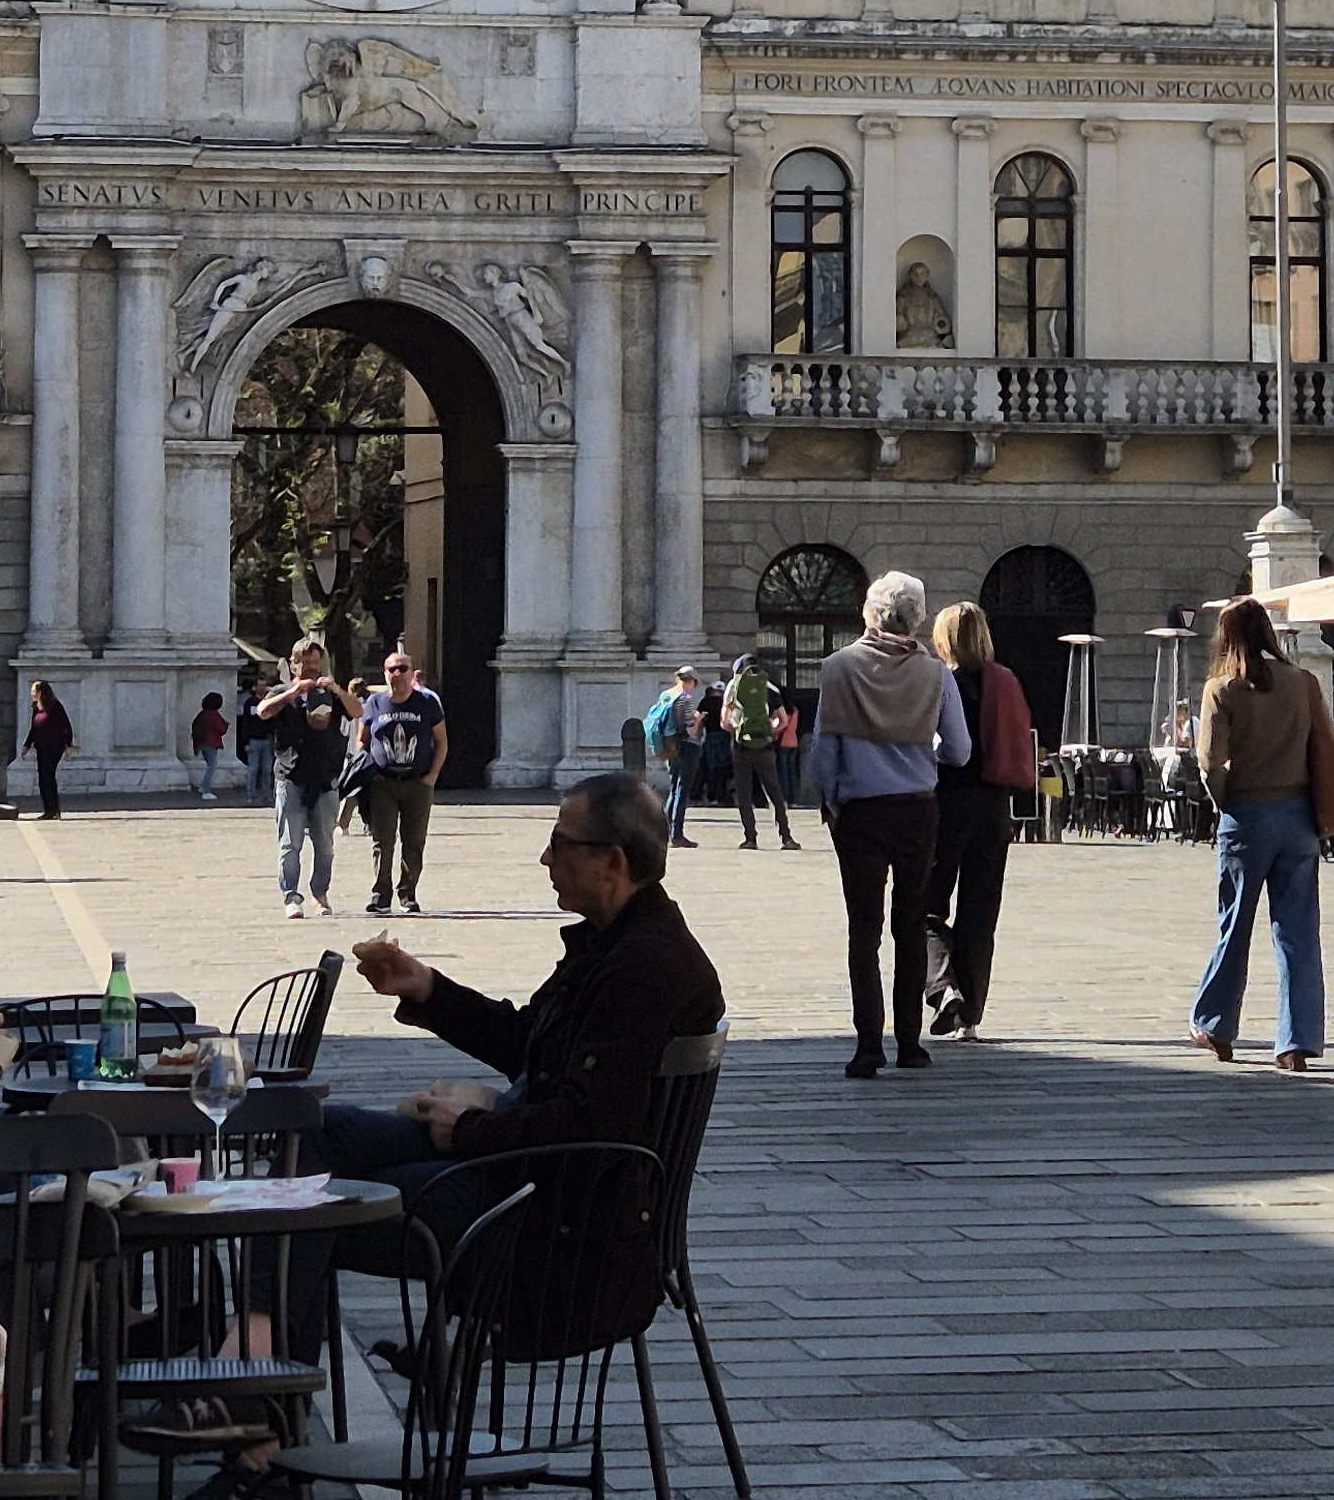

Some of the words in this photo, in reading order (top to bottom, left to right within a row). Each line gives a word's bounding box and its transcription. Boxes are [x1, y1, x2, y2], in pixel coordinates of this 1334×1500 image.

[754, 73, 801, 92] FORI
[814, 75, 914, 93] FRONTEM
[1027, 79, 1144, 97] HABITATIONI
[1155, 81, 1274, 99] SPECTACVLO
[43, 184, 162, 204] SENATVS
[198, 189, 314, 209] VENETVS
[335, 189, 449, 211] ANDREA
[474, 191, 554, 212] GRITI
[583, 192, 700, 212] PRINCIPE
